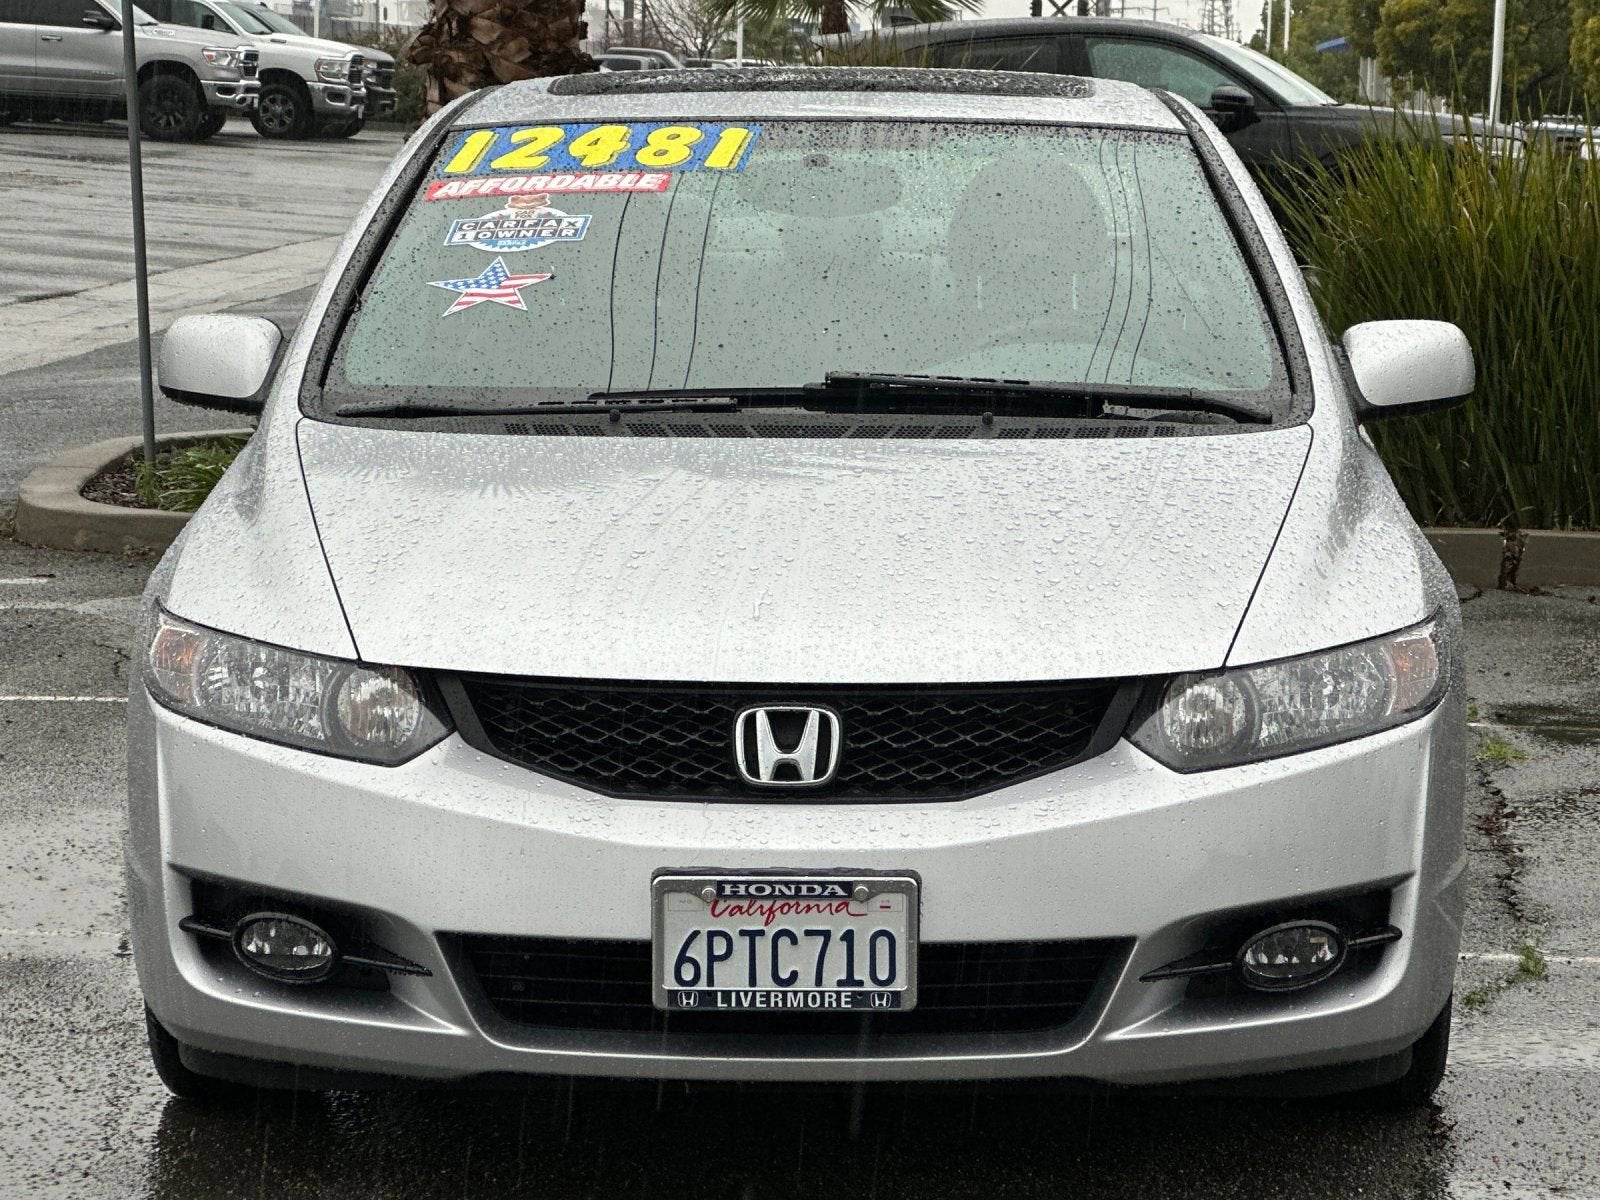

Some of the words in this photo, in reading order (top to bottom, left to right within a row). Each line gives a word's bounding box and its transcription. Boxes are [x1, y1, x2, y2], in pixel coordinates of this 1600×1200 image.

[443, 124, 753, 174] 12481
[432, 172, 665, 198] AFFORDABLE
[458, 231, 469, 240] 1
[476, 227, 576, 239] OWNER
[460, 217, 580, 231] CARFAX
[721, 883, 849, 897] HONDA
[709, 898, 868, 927] California
[673, 928, 898, 988] 6PTC710
[716, 991, 853, 1009] LIVERMORE
